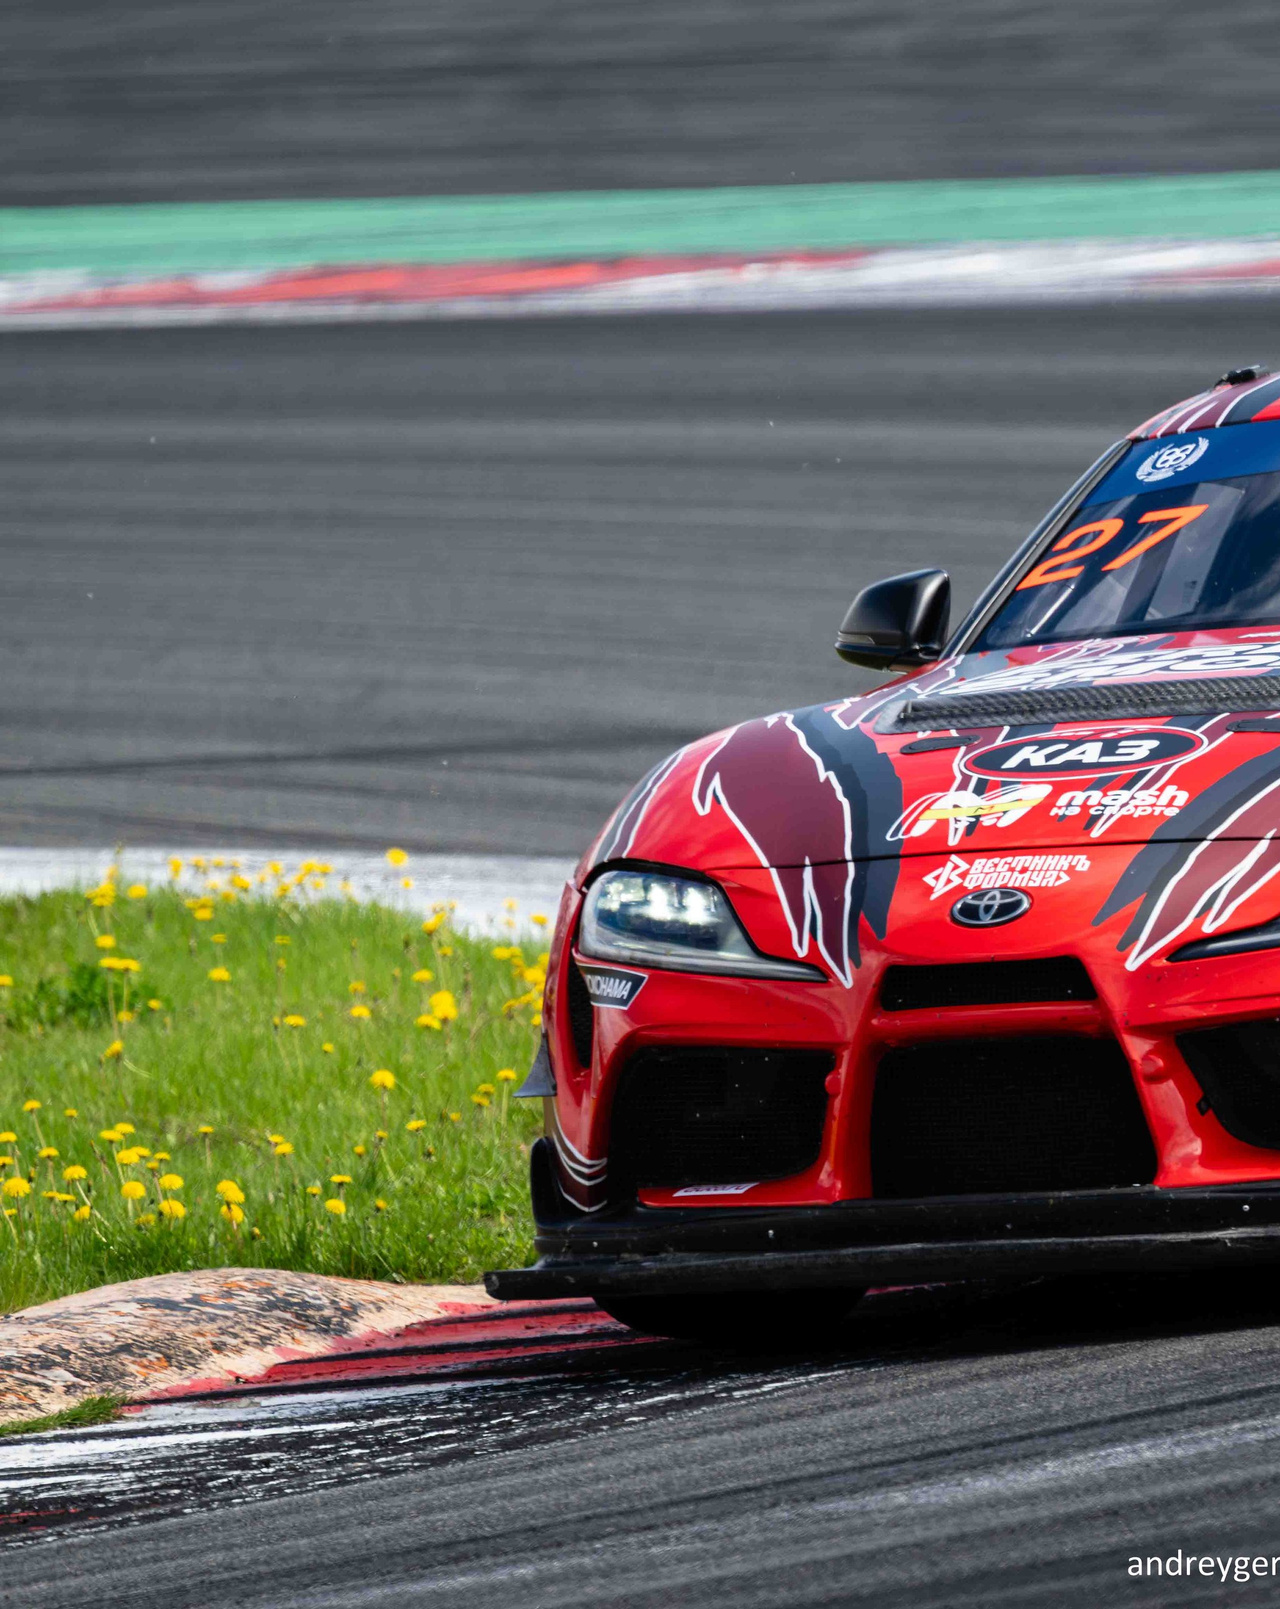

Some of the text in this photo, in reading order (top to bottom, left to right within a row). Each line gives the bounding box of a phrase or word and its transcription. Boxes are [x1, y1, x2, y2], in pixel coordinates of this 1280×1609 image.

[1016, 504, 1209, 590] 27
[1055, 785, 1190, 806] mash
[1049, 805, 1180, 818] на спорте
